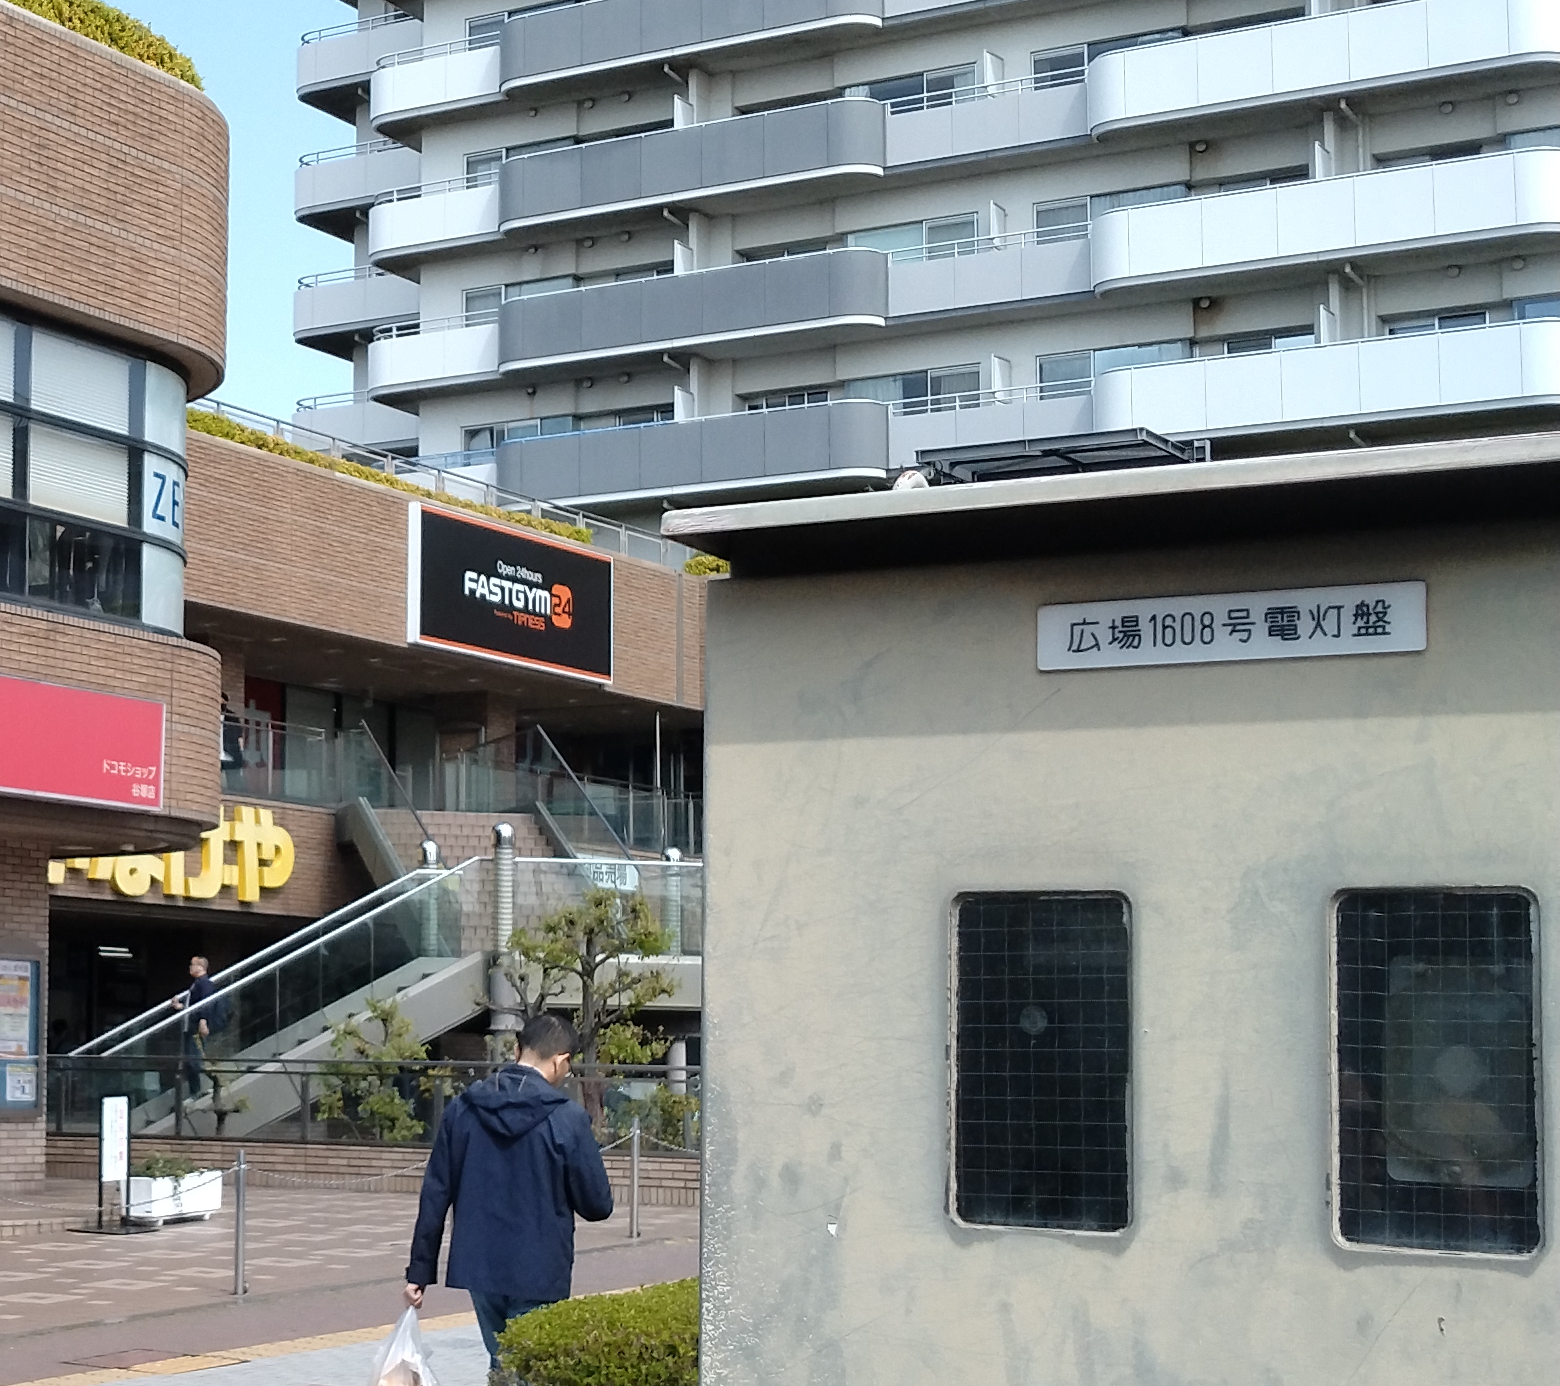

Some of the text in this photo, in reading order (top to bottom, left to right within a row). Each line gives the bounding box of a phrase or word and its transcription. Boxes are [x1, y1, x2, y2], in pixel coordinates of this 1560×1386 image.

[1067, 599, 1392, 653] 広場1608号電灯盤
[103, 759, 157, 780] ドコモショップ
